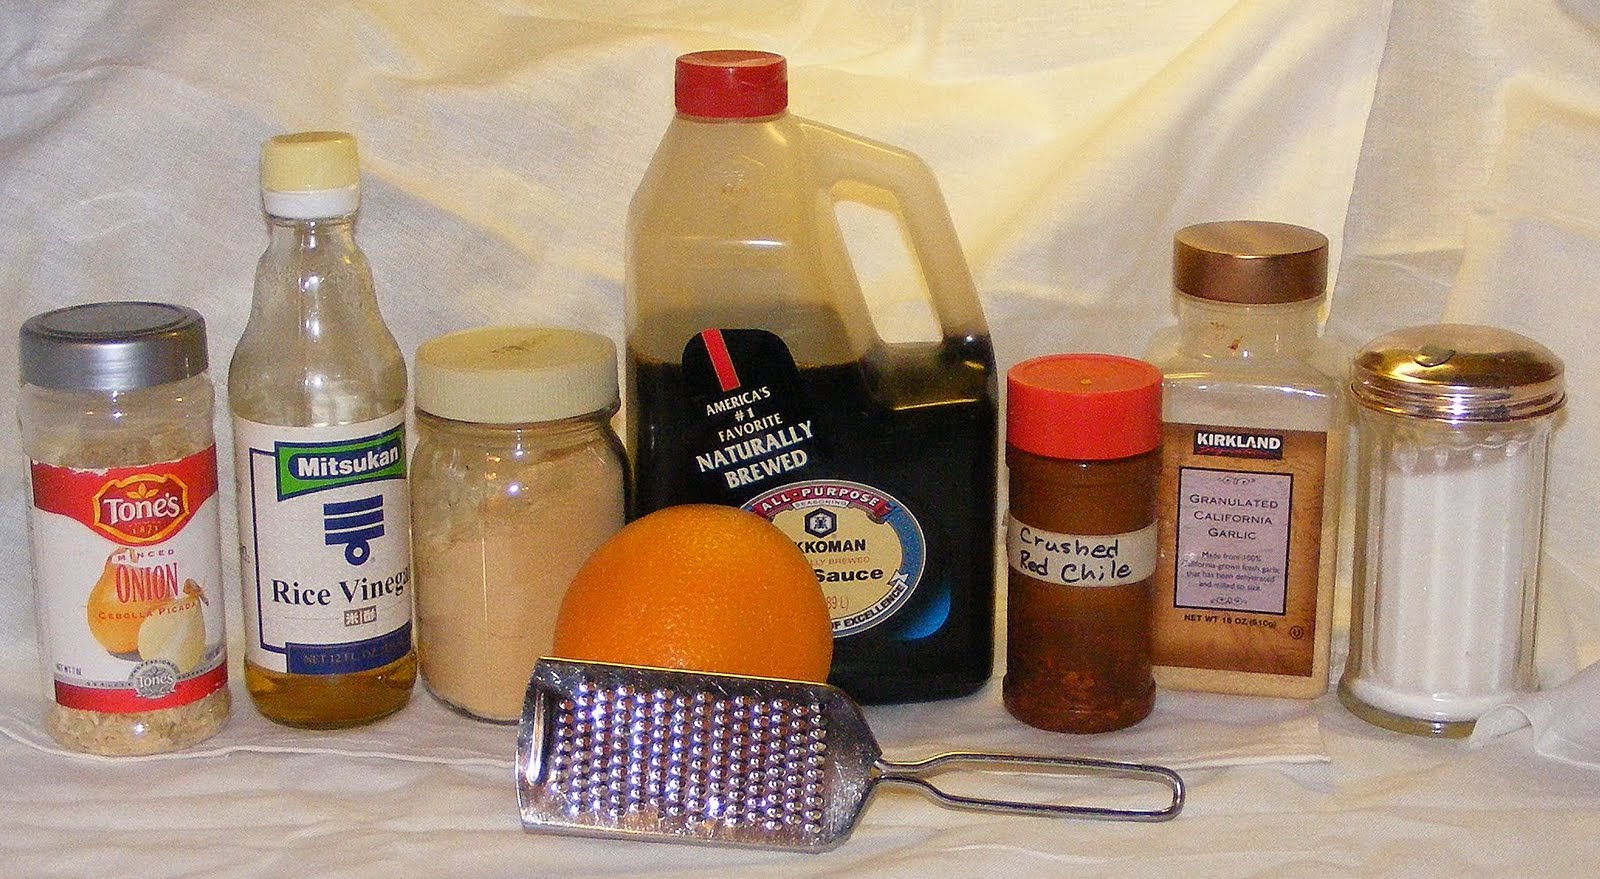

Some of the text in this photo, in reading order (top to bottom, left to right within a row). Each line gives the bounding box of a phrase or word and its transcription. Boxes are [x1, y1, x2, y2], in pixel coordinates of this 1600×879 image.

[706, 386, 771, 416] AMERICA'S
[718, 412, 783, 442] FAVORITE
[696, 420, 813, 473] NATURALLY
[1197, 432, 1281, 450] KIRKLAND
[297, 446, 399, 477] Mitsukan
[724, 450, 808, 489] BREWED
[103, 492, 180, 525] Tone's
[761, 486, 880, 512] ALL-PURPOSE
[1189, 494, 1279, 509] GRANULATED
[1193, 510, 1273, 525] CALIFORNIA
[794, 539, 866, 554] KKOMAN
[1020, 527, 1119, 559] Crushed
[1208, 527, 1257, 540] GARLIC
[117, 549, 175, 561] MINCED
[1020, 550, 1132, 583] Red Chile
[115, 562, 179, 604] ONION
[814, 568, 884, 583] Sauce
[271, 579, 331, 606] Rice
[844, 584, 904, 628] EXCELLENCE
[98, 602, 198, 620] CEBOLLA PICADA
[1184, 614, 1202, 622] NET
[1205, 615, 1218, 623] WT
